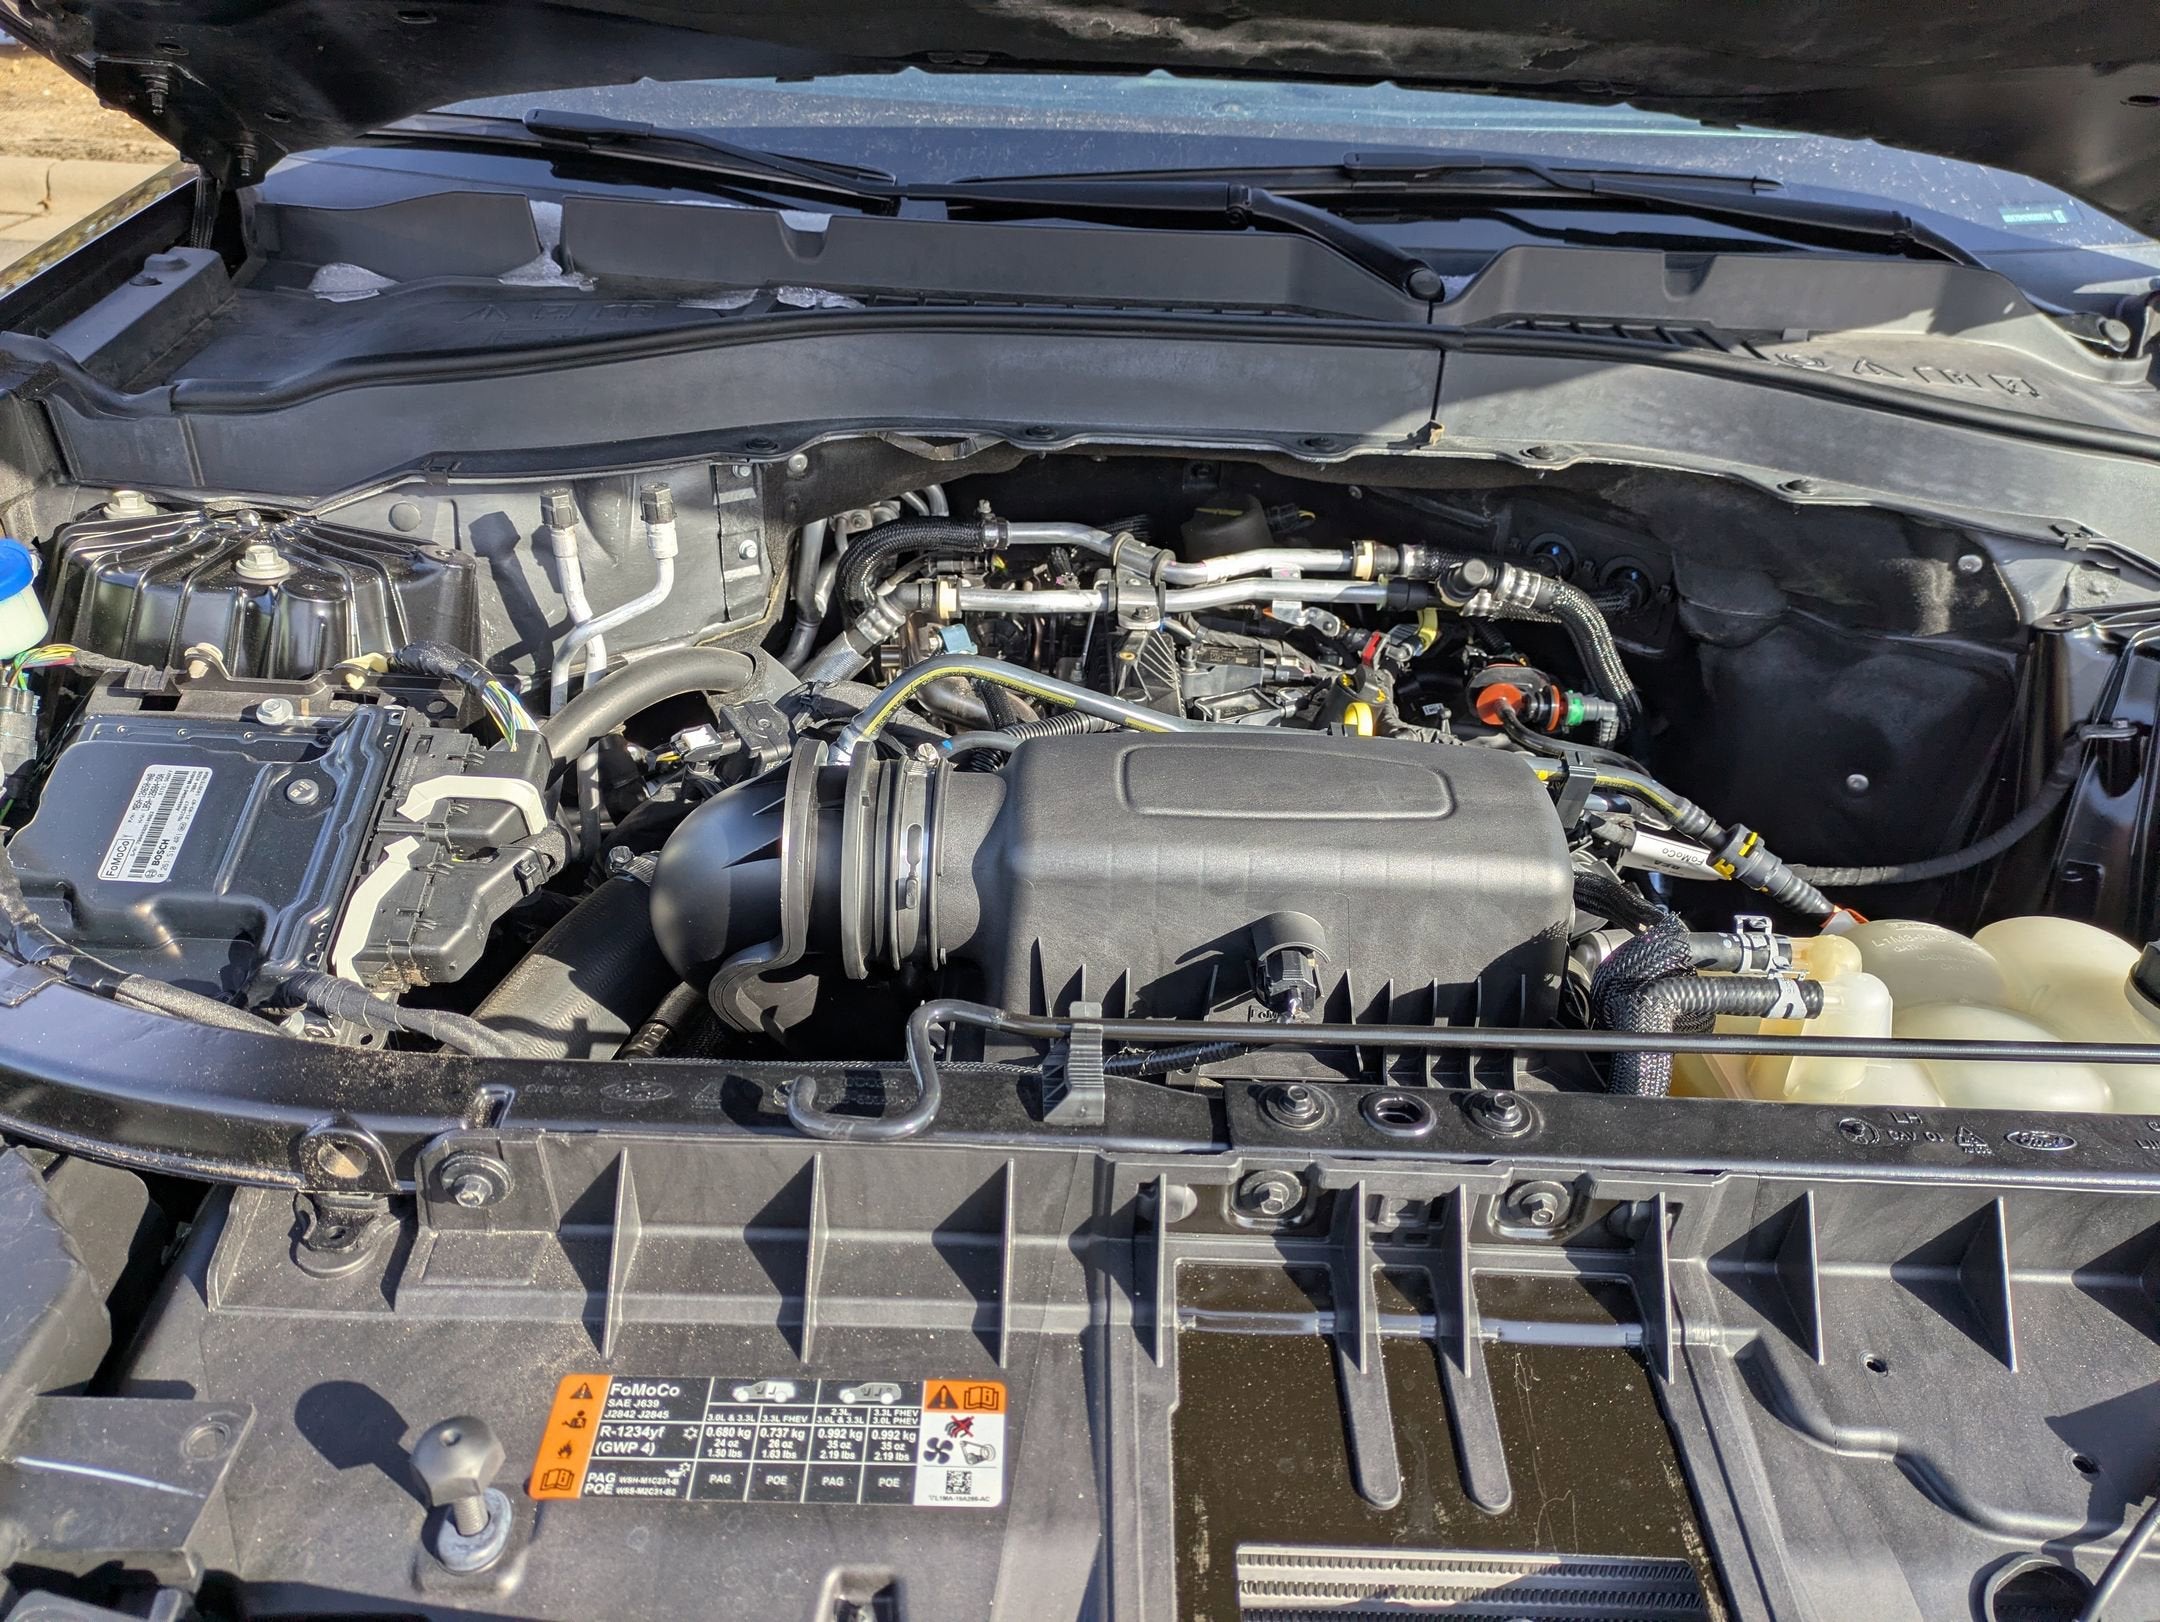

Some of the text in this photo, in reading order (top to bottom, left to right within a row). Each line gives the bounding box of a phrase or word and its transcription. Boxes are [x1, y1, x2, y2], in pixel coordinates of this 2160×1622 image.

[151, 839, 170, 866] BOSCH
[1662, 848, 1706, 866] FoMoCo
[106, 841, 130, 876] FoMoCo
[609, 1383, 681, 1397] FoMoCo
[607, 1399, 660, 1408] SAE J639
[604, 1410, 670, 1420] J2842 J2845
[727, 1414, 735, 1422] &
[894, 1409, 919, 1417] FHEV
[782, 1414, 808, 1423] FHEV
[837, 1416, 844, 1424] &
[600, 1426, 666, 1440] R-1234yf
[705, 1427, 752, 1440] 0.680 kg
[760, 1427, 805, 1441] 0.737 kg
[817, 1428, 864, 1441] 0.992 kg
[871, 1429, 917, 1442] 0.992 kg
[713, 1438, 740, 1448] 24 oz
[768, 1439, 794, 1449] 26 oz
[826, 1440, 852, 1449] 35 oz
[880, 1441, 906, 1451] 35 oz
[595, 1441, 656, 1456] (GWP 4)
[707, 1448, 743, 1458] 1.50 lbs
[762, 1449, 797, 1459] 1.63 lbs
[819, 1449, 856, 1460] 2.19 lbs
[873, 1451, 910, 1461] 2.19 lbs
[587, 1472, 616, 1483] PAG
[708, 1474, 732, 1484] PAG
[765, 1475, 788, 1486] POE
[821, 1476, 844, 1487] PAG
[878, 1477, 901, 1487] POE
[584, 1483, 613, 1495] POE
